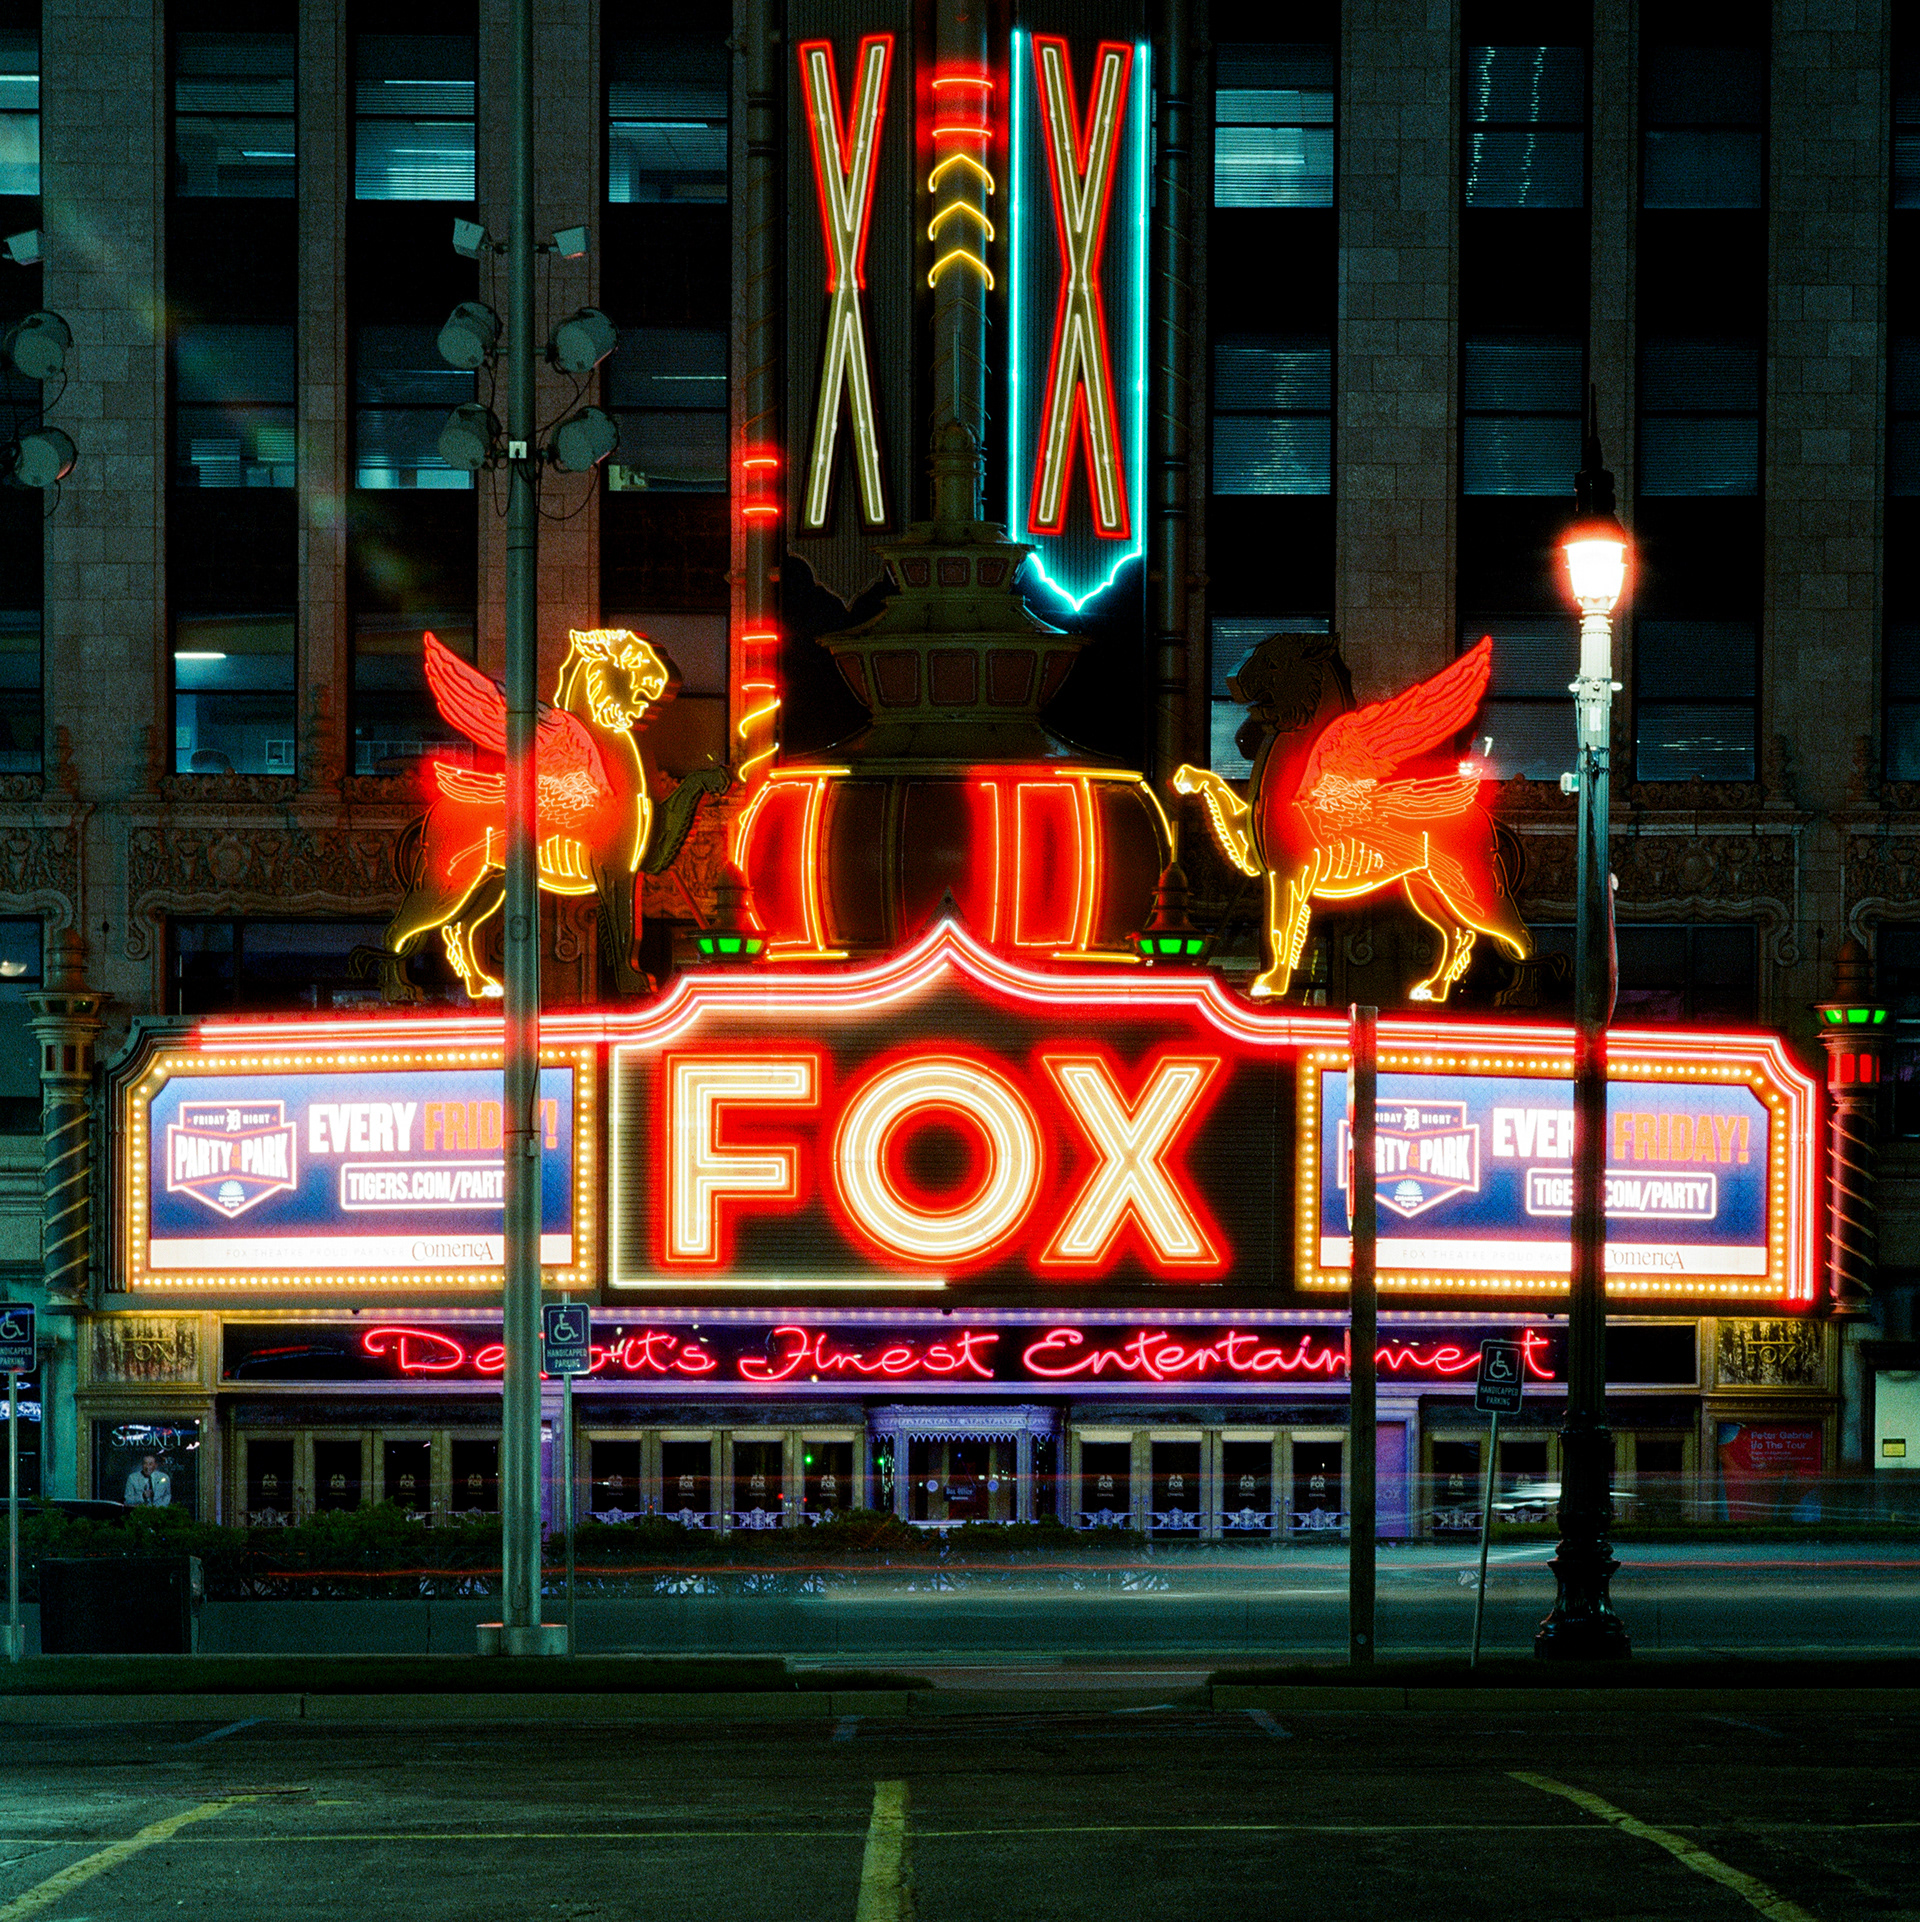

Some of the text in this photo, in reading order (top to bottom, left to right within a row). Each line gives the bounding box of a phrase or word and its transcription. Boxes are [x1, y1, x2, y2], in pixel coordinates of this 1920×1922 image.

[193, 1114, 225, 1126] FRIDAY
[242, 1113, 270, 1124] NIGHT
[308, 1099, 558, 1153] EVERY FRID!
[1421, 1113, 1451, 1125] NIGHT
[1492, 1107, 1749, 1163] EVER FRIDAY!
[175, 1134, 233, 1181] PARTY
[241, 1132, 288, 1179] PARK
[666, 1054, 1221, 1263] FOX
[1419, 1134, 1471, 1181] PARK
[347, 1170, 505, 1203] TIGERS.COM/PART
[547, 1348, 588, 1358] HANDICAPPED
[554, 1358, 581, 1369] PARKING
[738, 1326, 1000, 1381] Finest
[1480, 1385, 1520, 1397] HANDICAPPED
[1486, 1396, 1511, 1407] PARKING
[111, 1427, 182, 1451] SMOKEY
[1785, 1440, 1807, 1450] Tour
